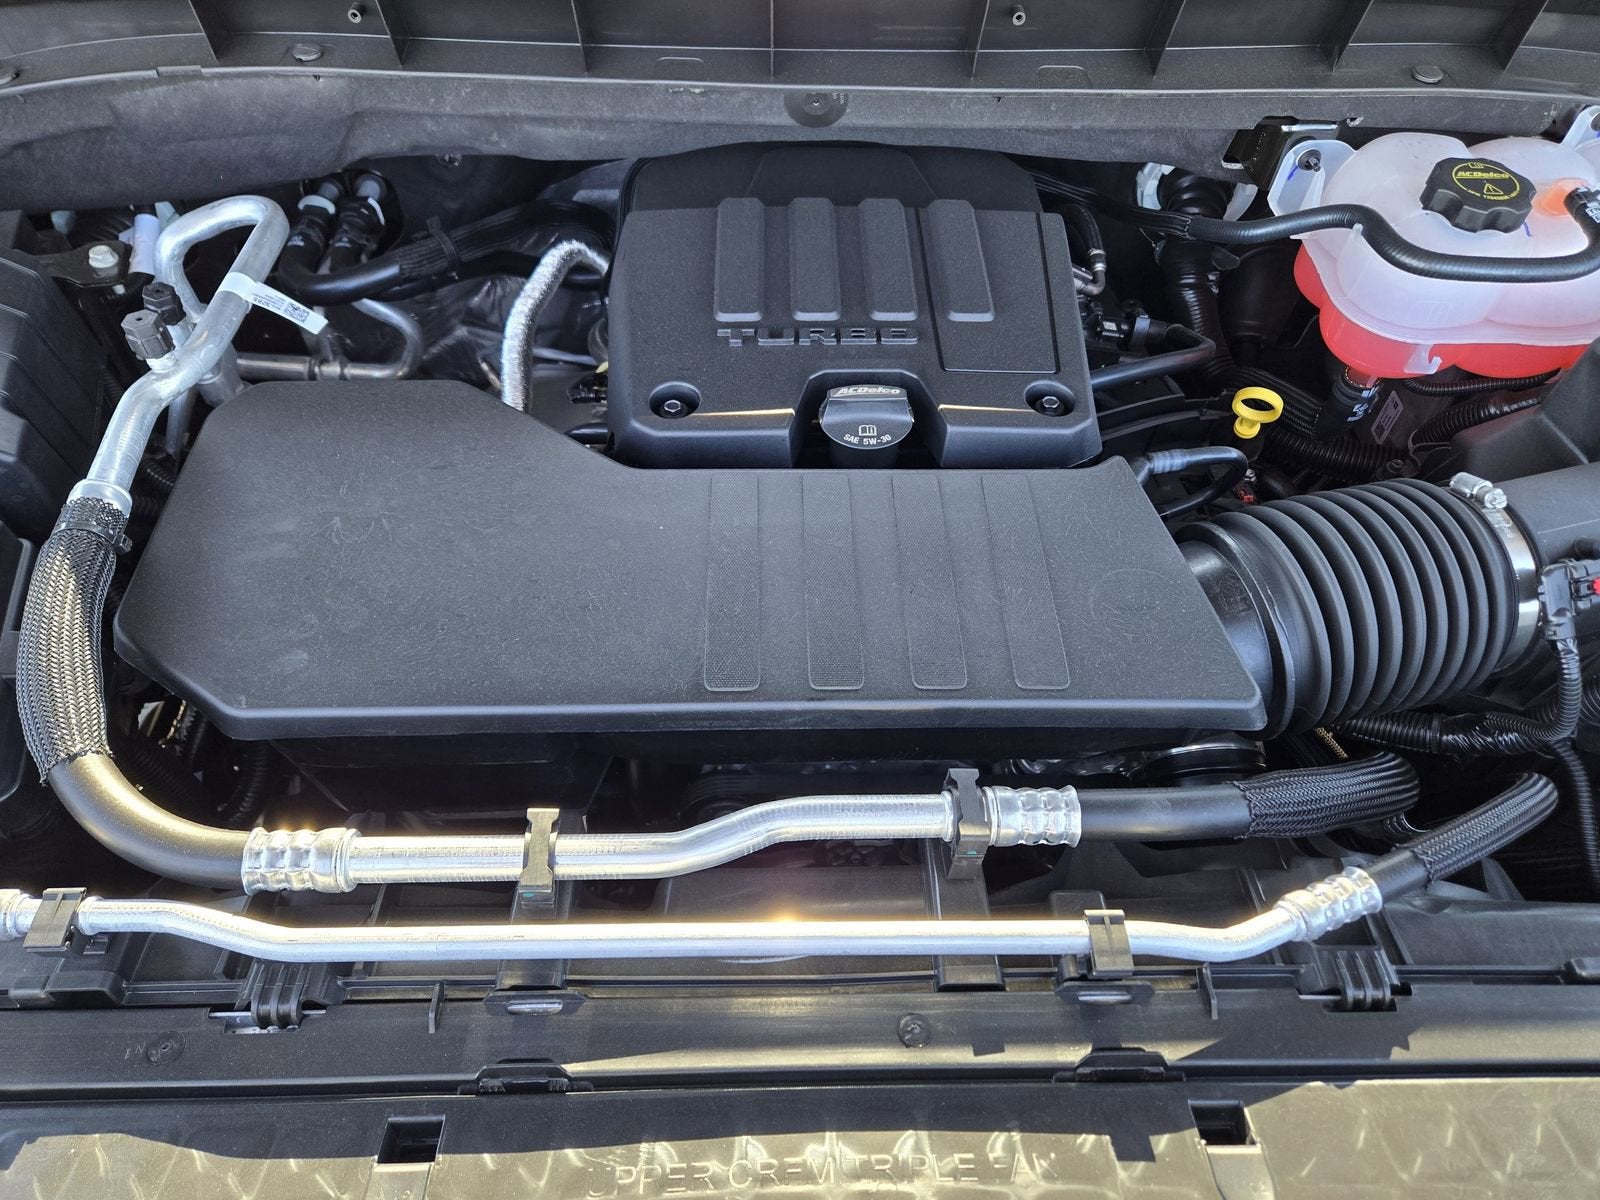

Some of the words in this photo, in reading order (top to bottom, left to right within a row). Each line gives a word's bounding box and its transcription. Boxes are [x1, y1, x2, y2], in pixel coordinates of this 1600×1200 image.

[1456, 171, 1510, 179] ACDelco
[716, 327, 919, 347] TURBO
[834, 386, 901, 397] ACDelco
[843, 433, 860, 444] SAE
[863, 434, 892, 445] 5W-30
[586, 1161, 715, 1198] UPPER
[845, 1152, 979, 1183] TRIPLE
[988, 1152, 1058, 1183] FAN
